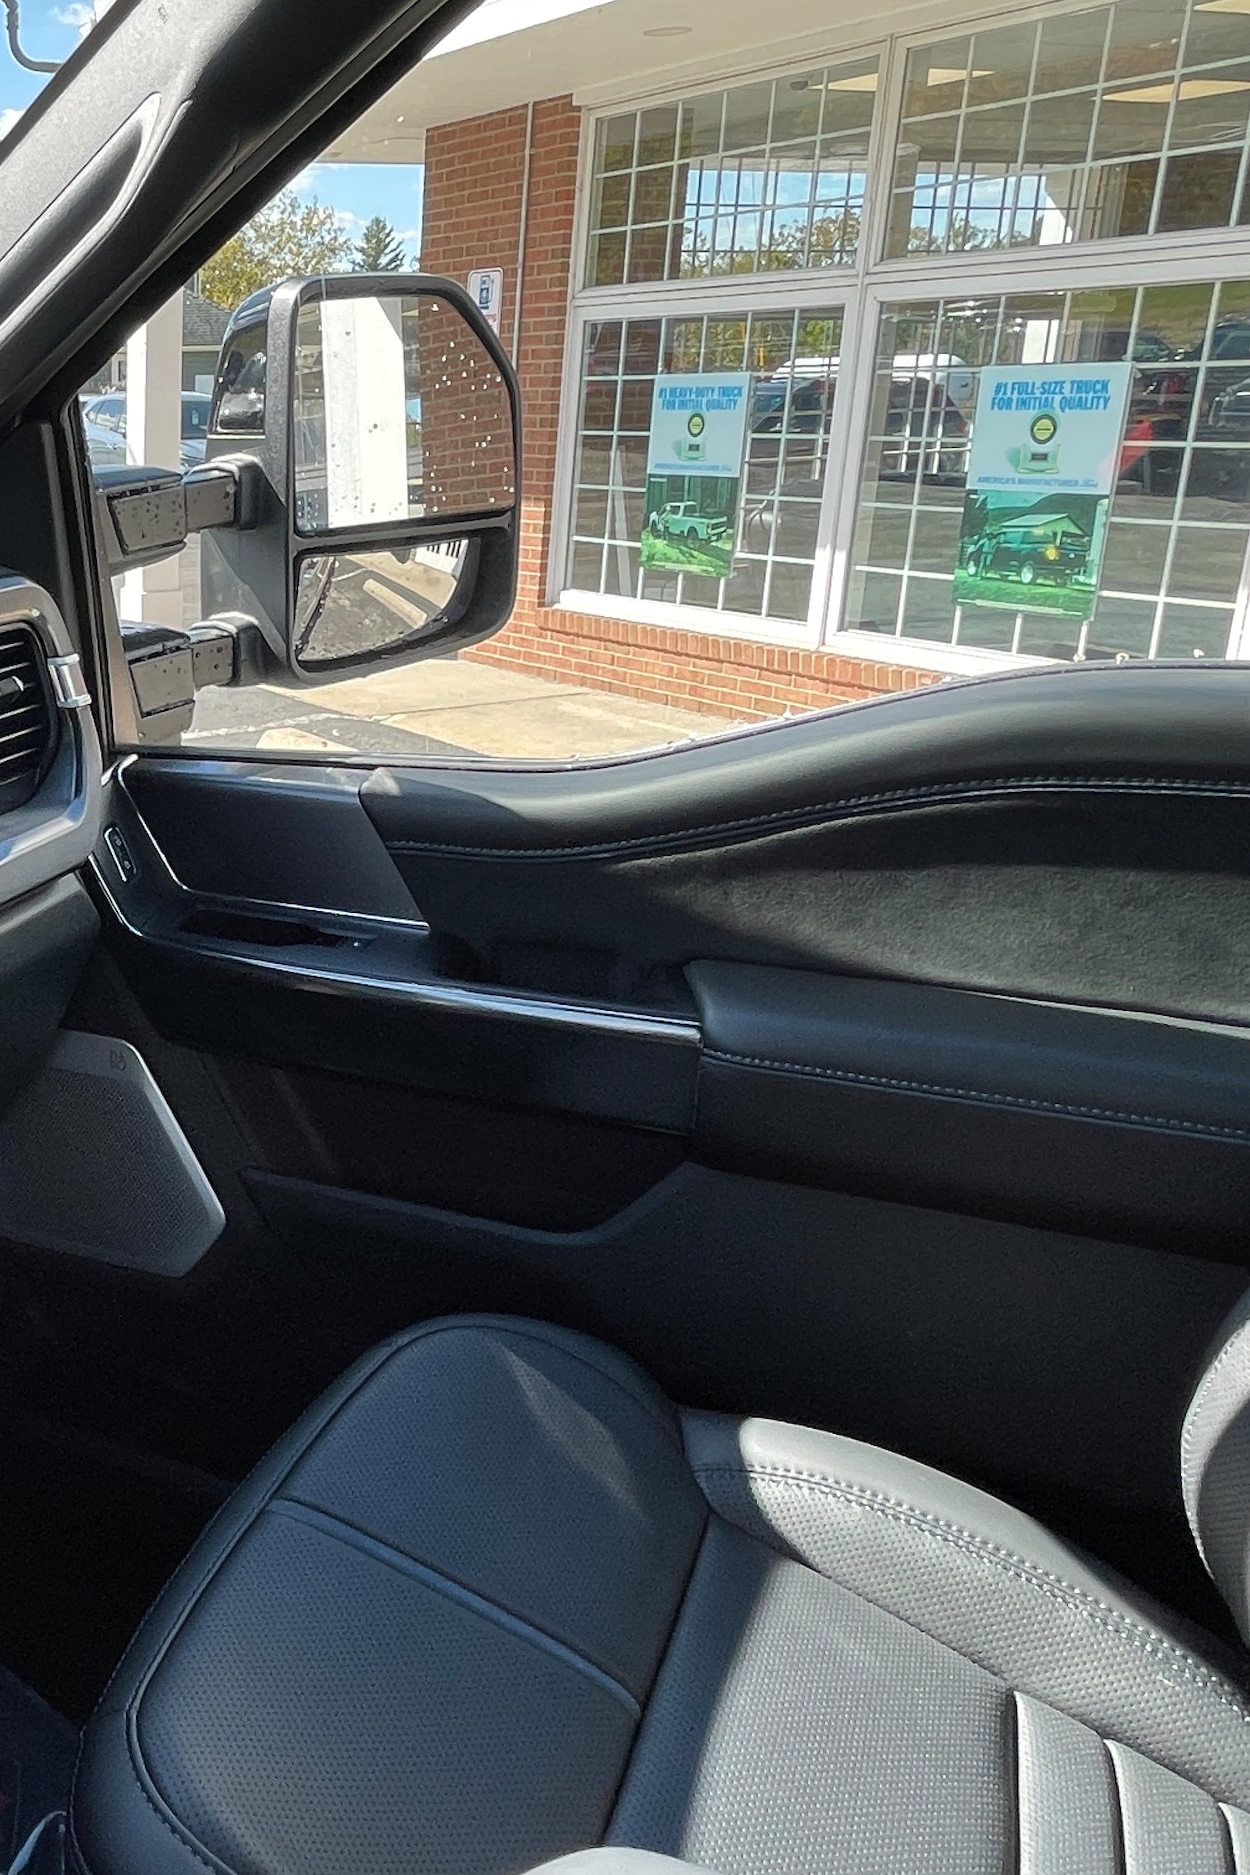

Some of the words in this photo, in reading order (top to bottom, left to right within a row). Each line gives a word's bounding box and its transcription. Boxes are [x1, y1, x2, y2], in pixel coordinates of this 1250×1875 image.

[718, 386, 744, 398] TRUCK
[1011, 380, 1067, 396] FULL-SIZE
[1069, 379, 1111, 395] TRUCK
[706, 398, 740, 412] QUALITY
[991, 396, 1013, 411] FOR
[1015, 396, 1056, 411] INITIAL
[1059, 395, 1111, 413] QUALITY
